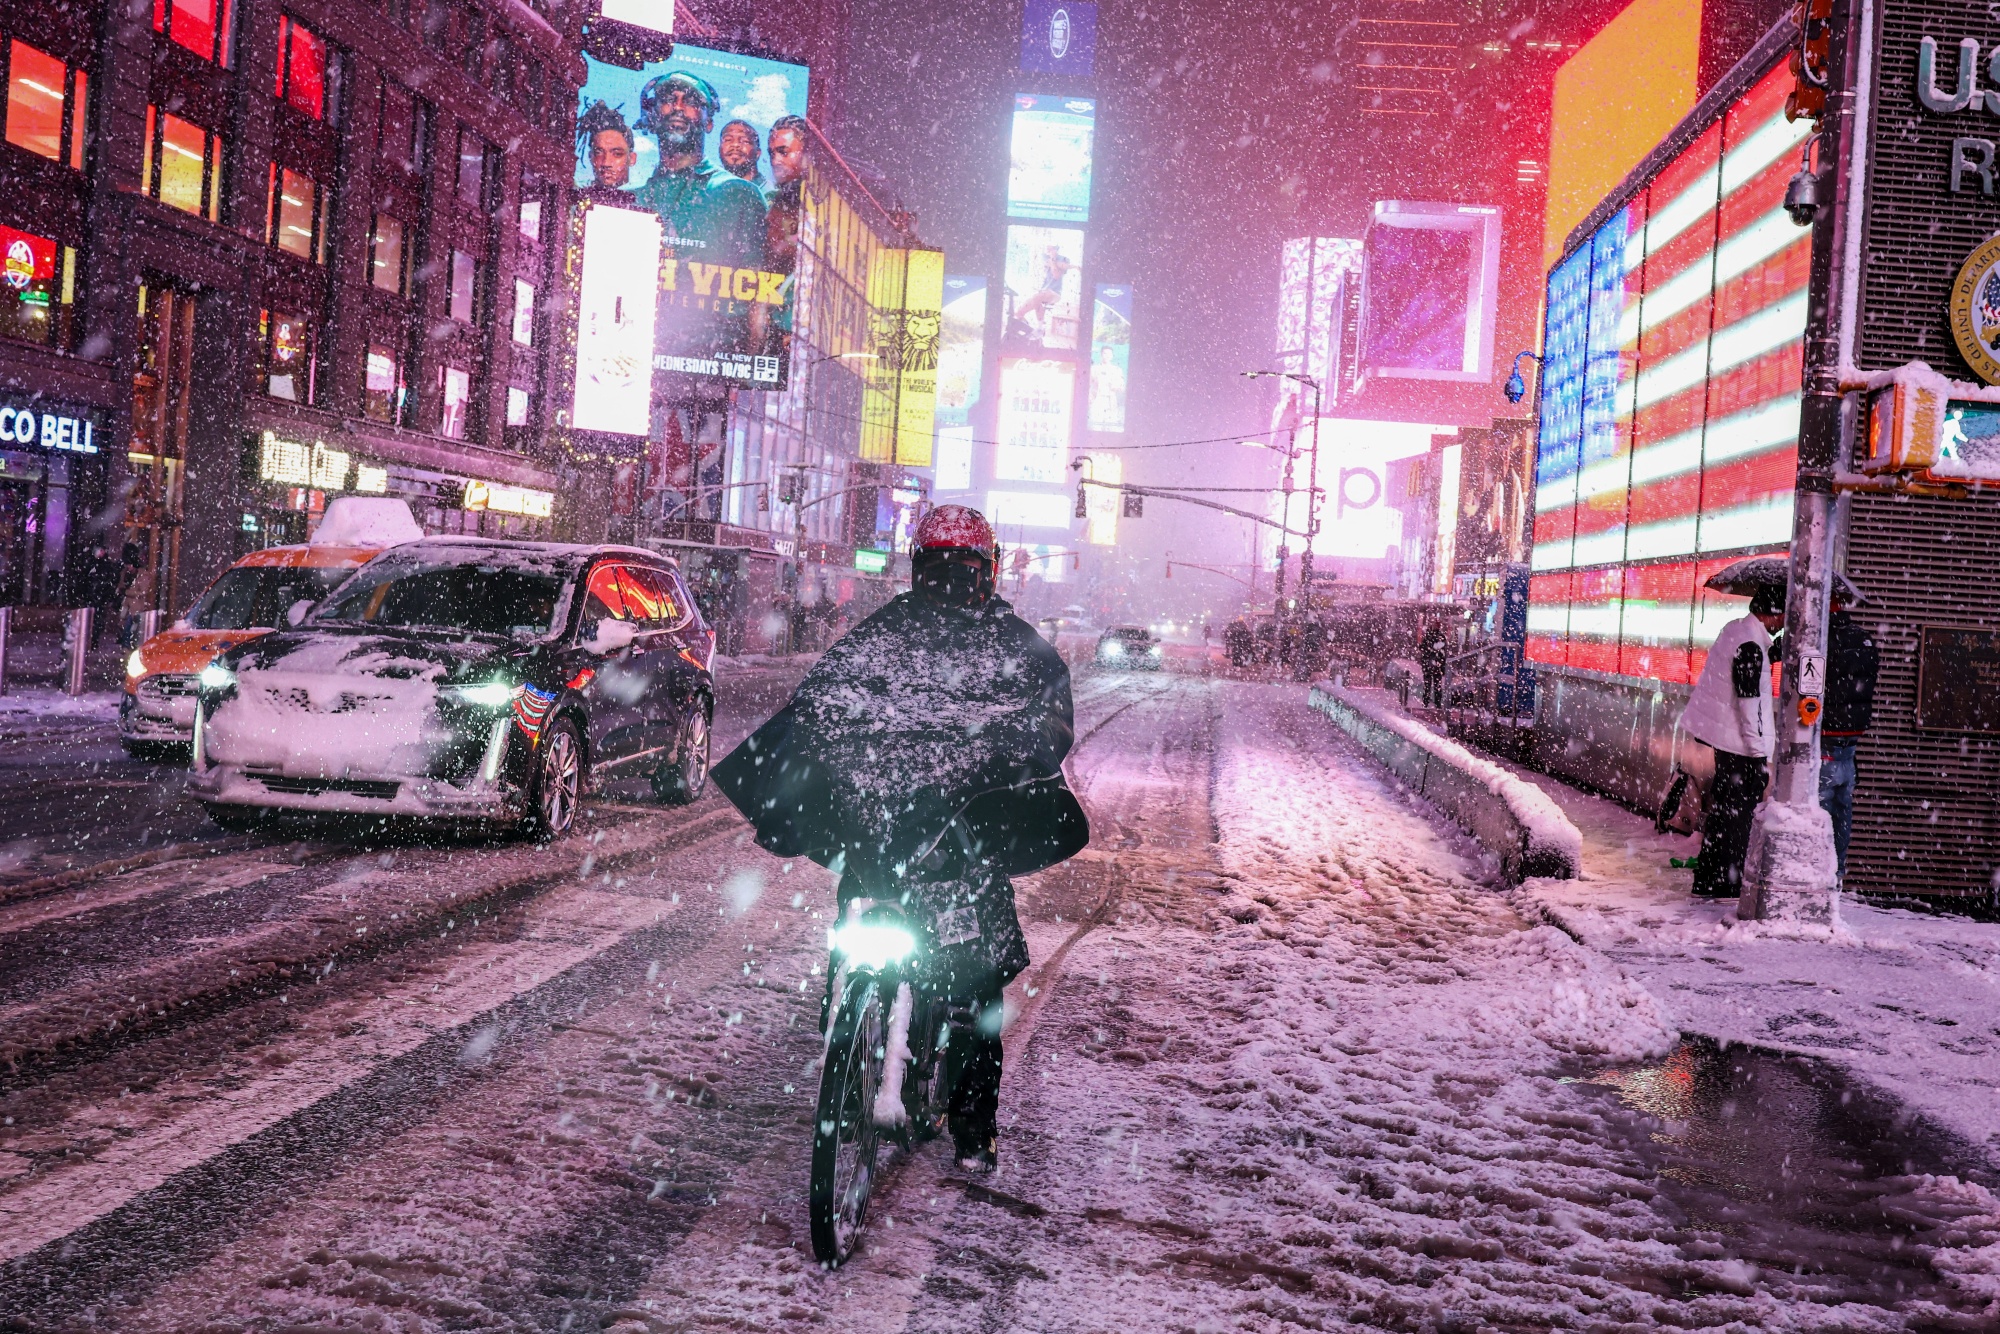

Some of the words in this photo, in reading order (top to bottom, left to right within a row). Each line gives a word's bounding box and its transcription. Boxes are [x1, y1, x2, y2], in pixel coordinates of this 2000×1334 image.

[688, 262, 786, 305] VICK
[714, 351, 729, 362] ALL
[731, 353, 752, 362] NEW
[41, 414, 98, 454] BELL
